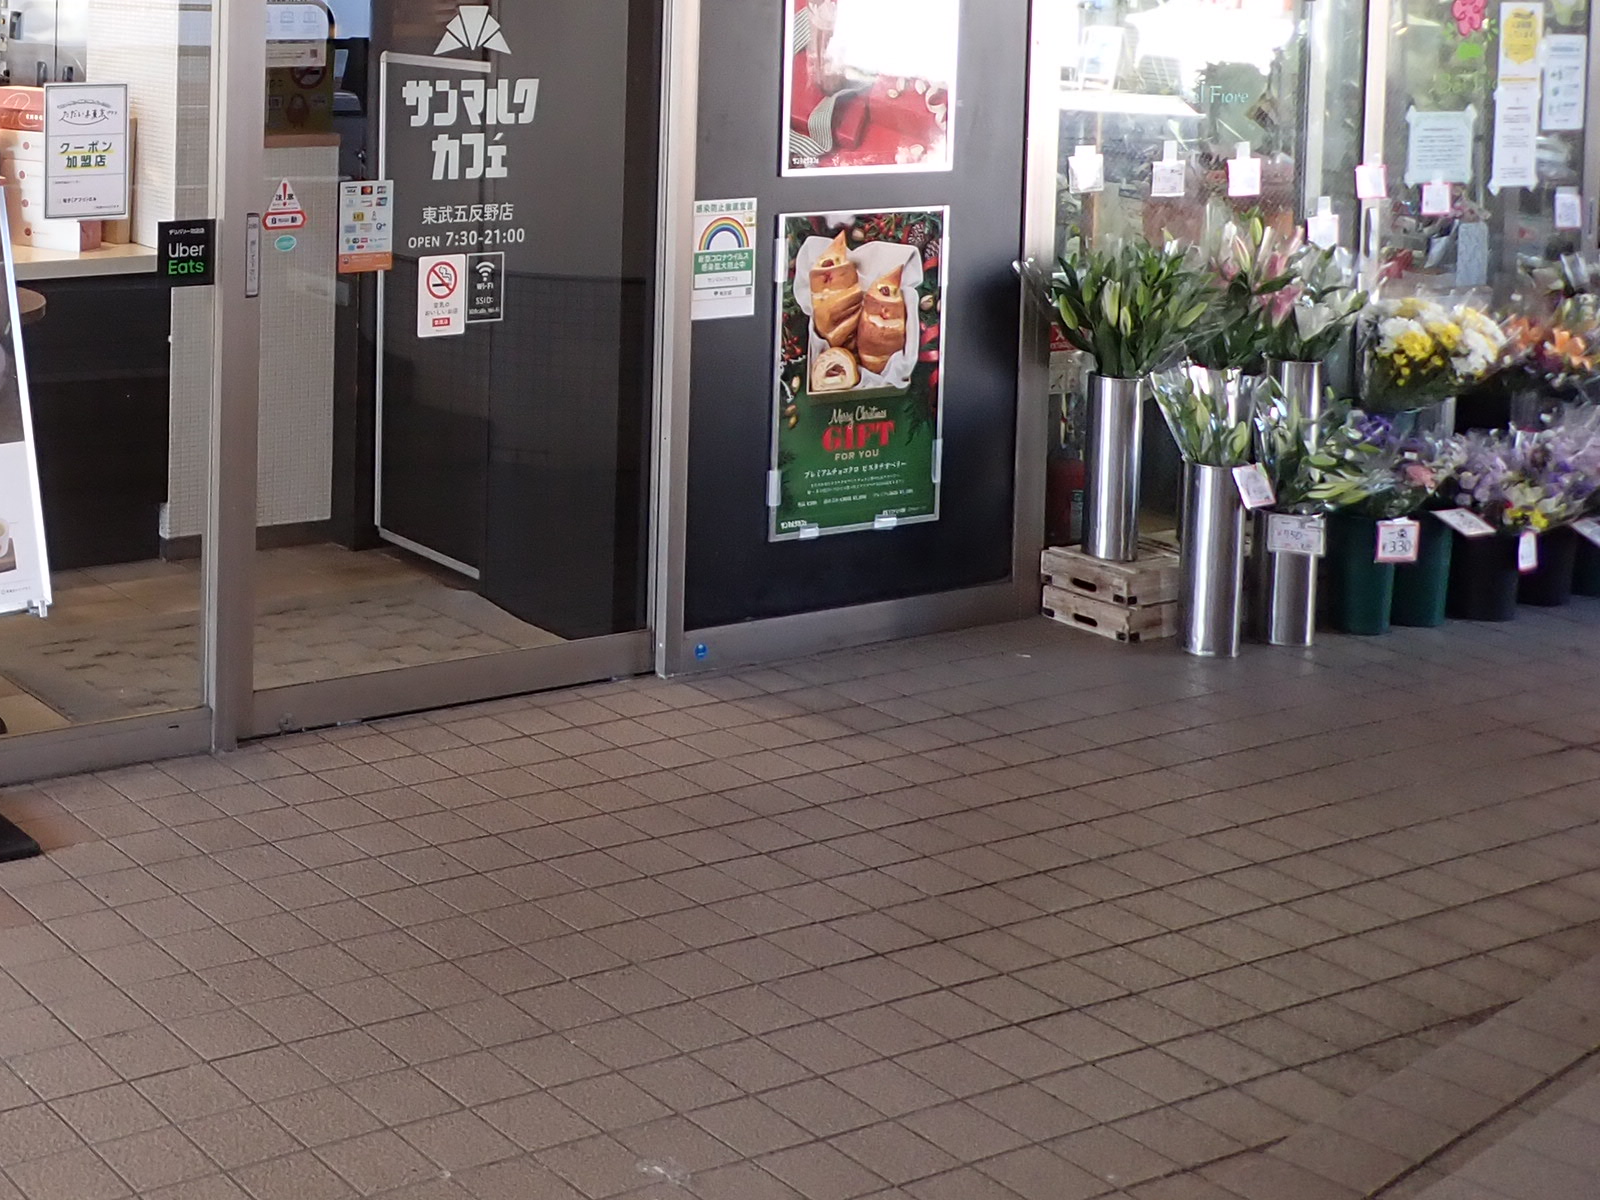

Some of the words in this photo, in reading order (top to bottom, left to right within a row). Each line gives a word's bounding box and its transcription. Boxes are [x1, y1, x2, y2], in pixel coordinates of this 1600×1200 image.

[401, 78, 540, 127] サンマルク
[1209, 85, 1249, 104] Fiore
[59, 140, 113, 154] クーポン
[431, 132, 508, 181] カフェ
[65, 154, 107, 168] 加盟店
[421, 203, 515, 225] 東武五反野店
[408, 236, 440, 249] OPEN
[445, 228, 525, 247] 7:30-21:00
[168, 242, 205, 258] Uber
[167, 259, 205, 275] Eats
[828, 409, 854, 429] Merry
[822, 420, 896, 452] GIFT
[834, 452, 856, 461] FOR
[859, 449, 880, 458] YOU
